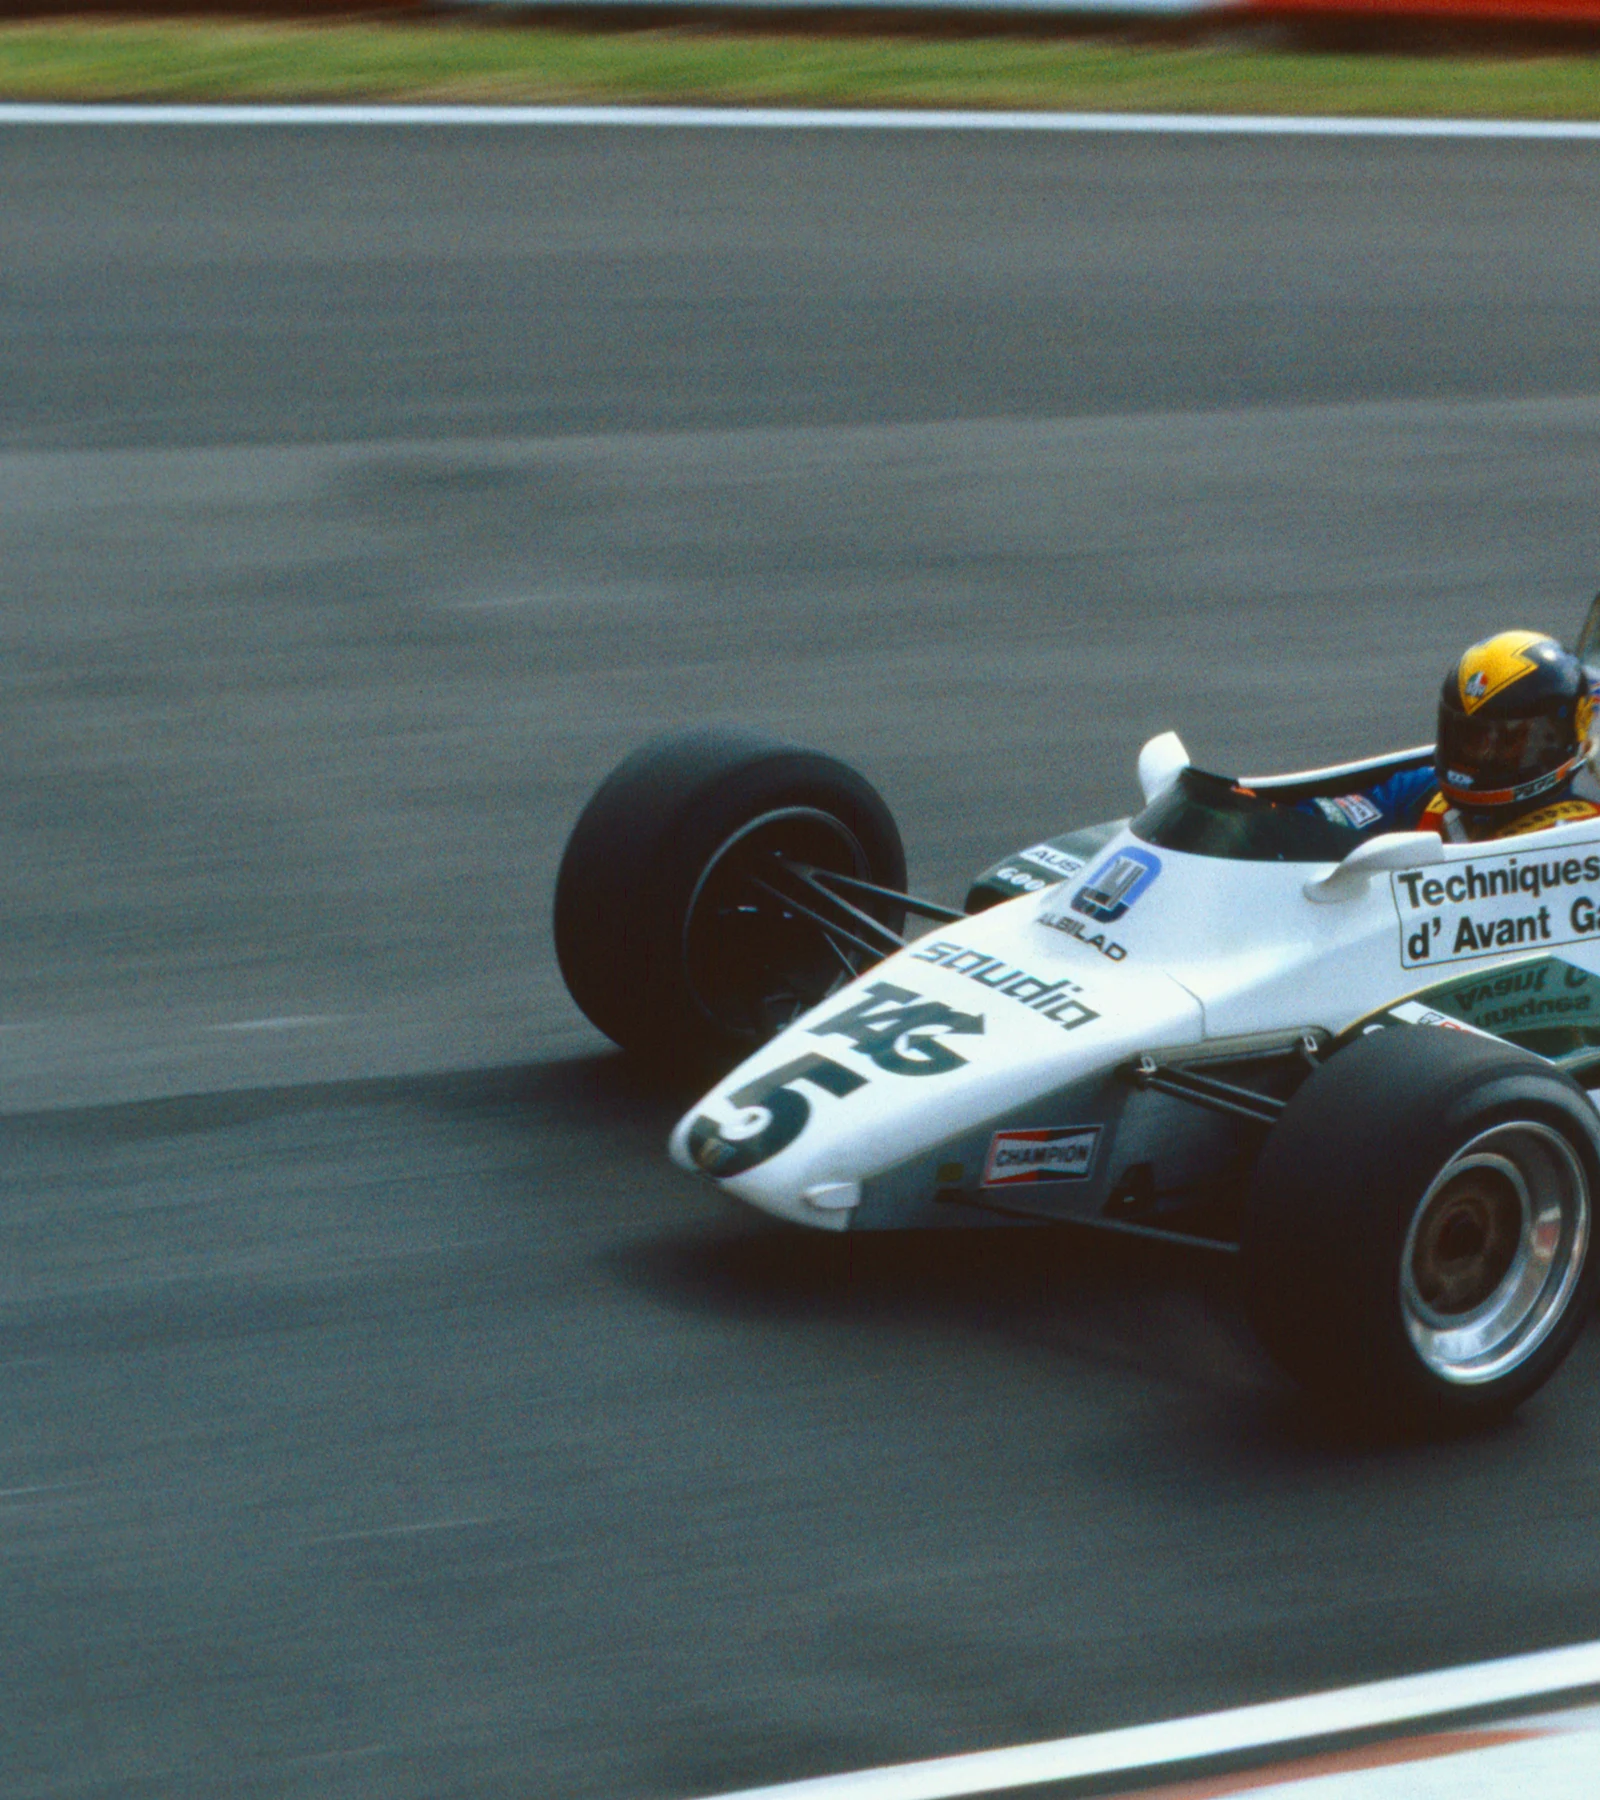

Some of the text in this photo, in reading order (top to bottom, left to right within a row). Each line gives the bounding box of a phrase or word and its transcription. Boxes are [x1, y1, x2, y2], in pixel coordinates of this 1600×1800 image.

[1452, 906, 1551, 954] Avant
[807, 981, 986, 1077] TAG
[910, 941, 1101, 1032] saudia
[687, 1051, 870, 1179] 5
[995, 1144, 1091, 1168] CHAMPION
